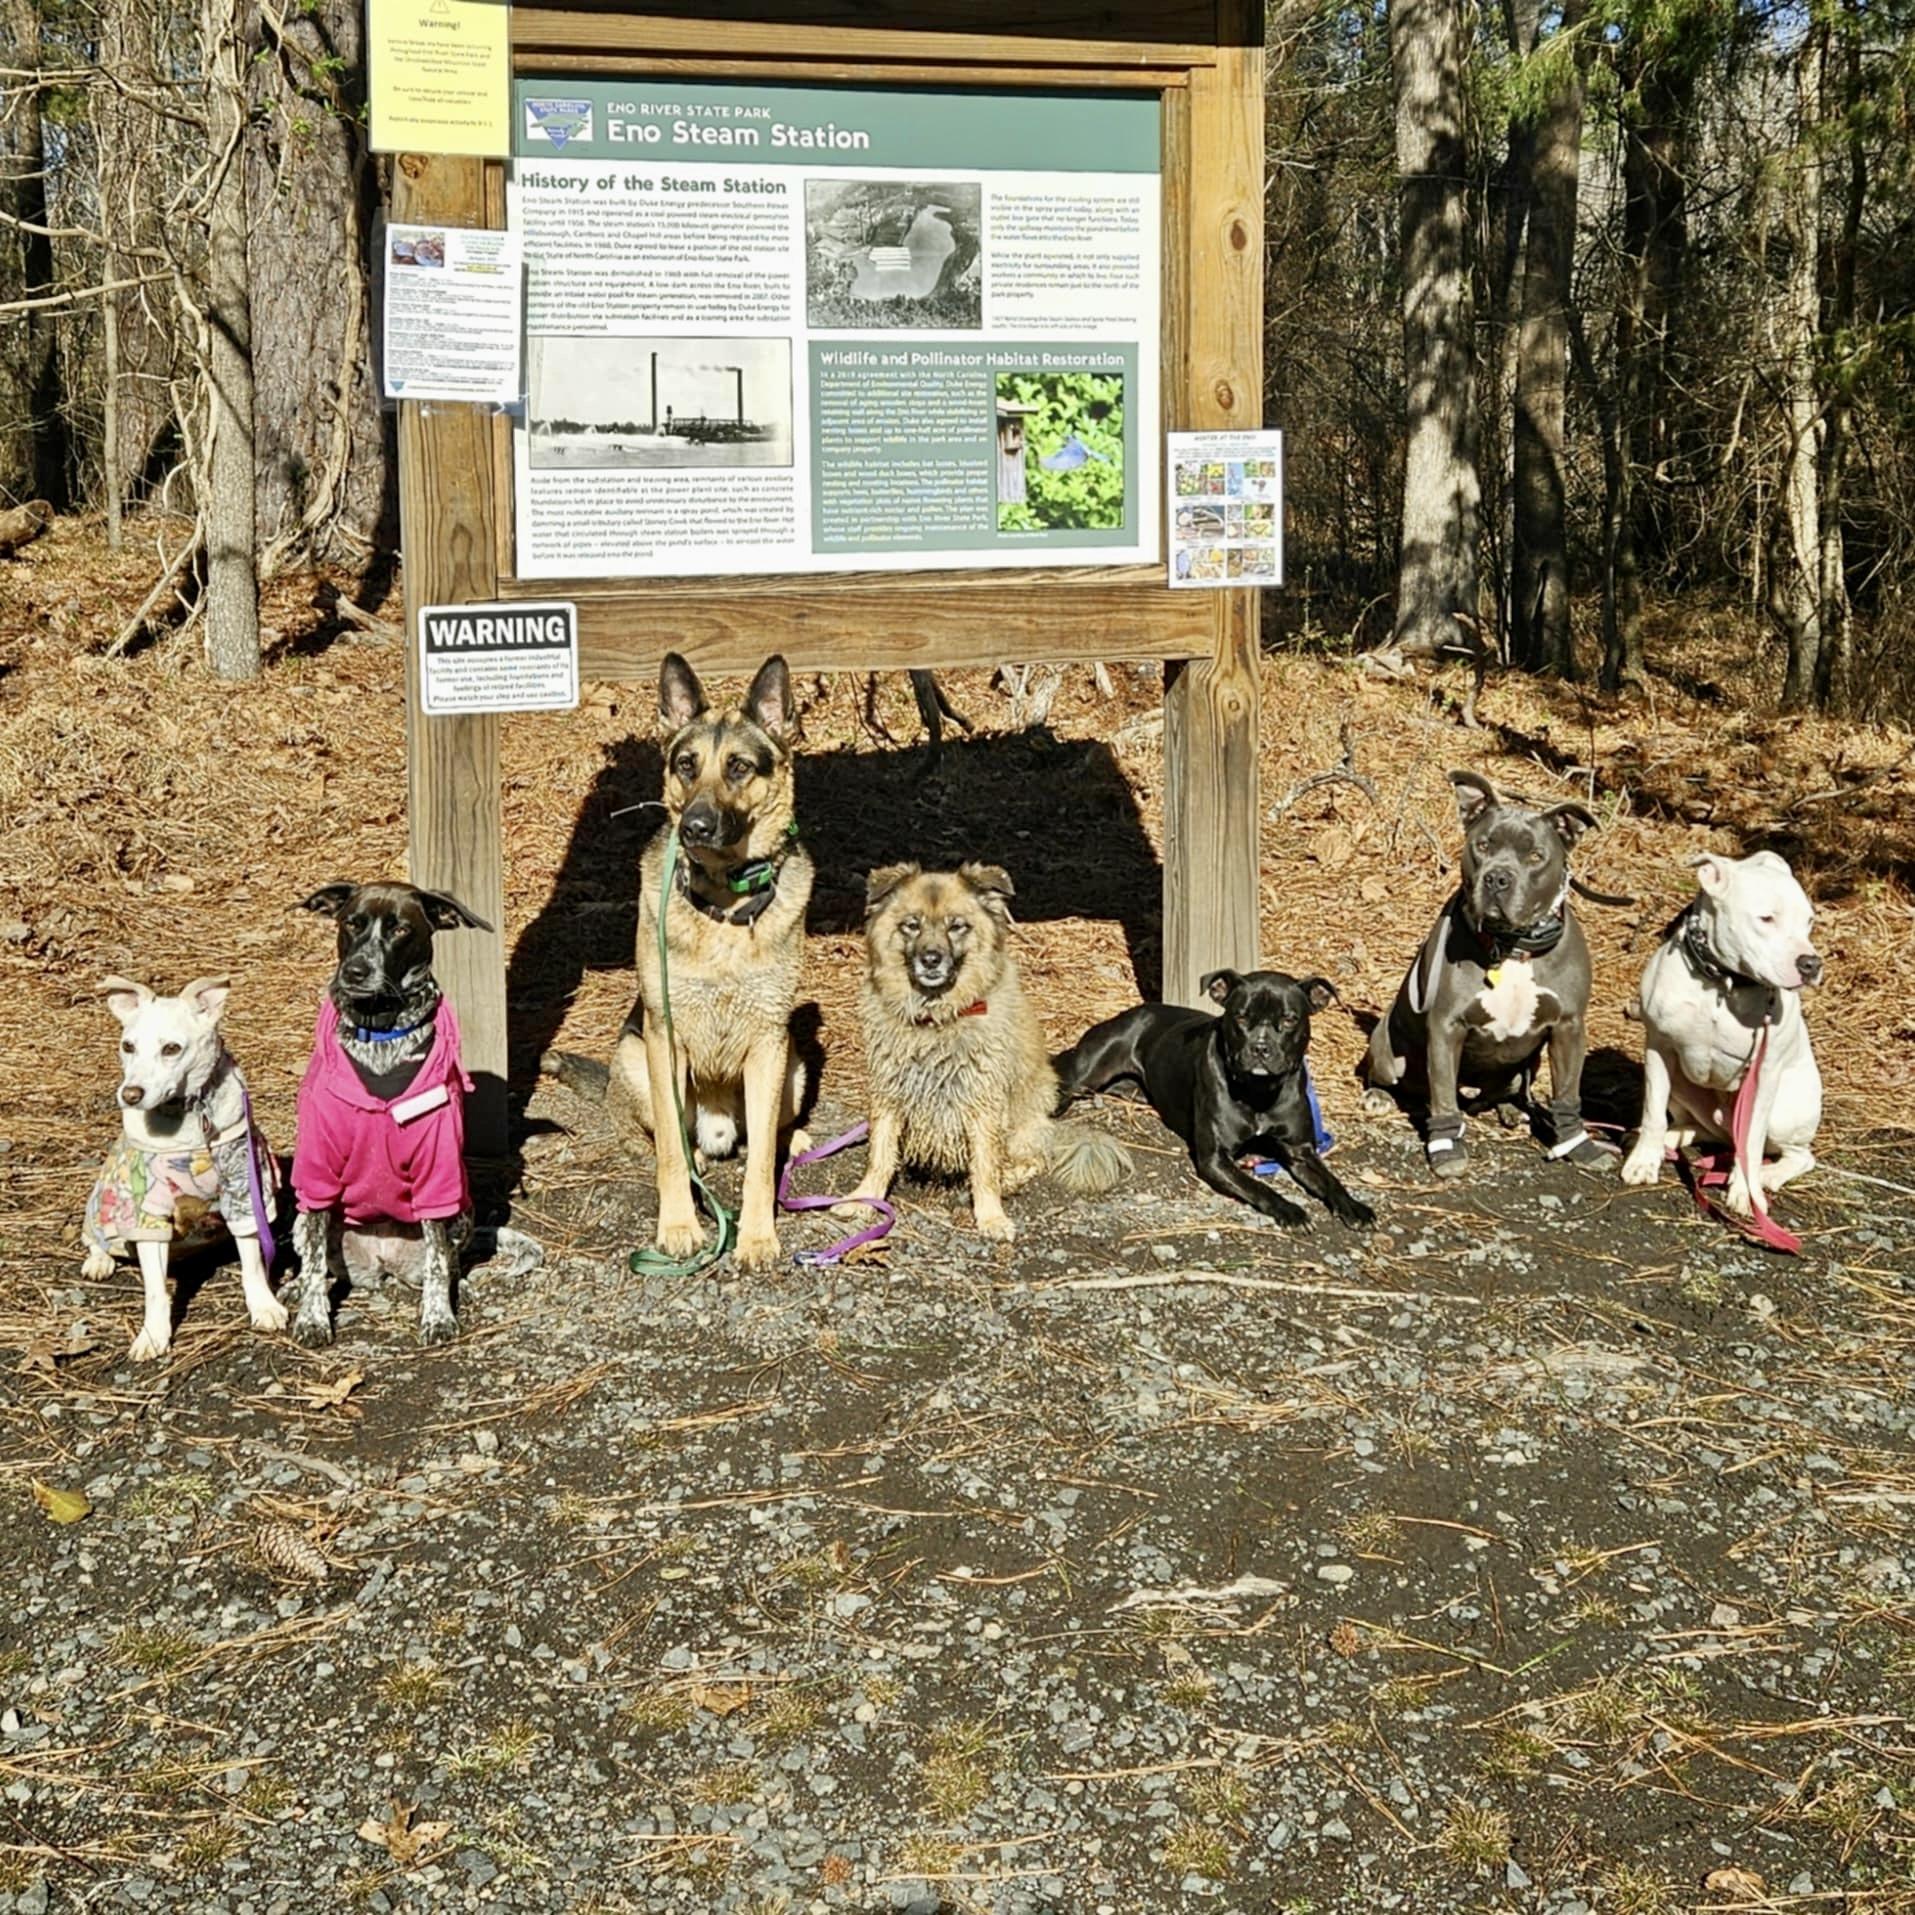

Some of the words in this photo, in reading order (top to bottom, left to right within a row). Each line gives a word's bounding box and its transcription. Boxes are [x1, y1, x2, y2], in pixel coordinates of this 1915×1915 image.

[418, 18, 461, 31] Warning!
[607, 102, 636, 114] ENO
[640, 103, 682, 116] RIVER
[687, 104, 731, 117] STATE
[734, 106, 771, 119] PARK
[607, 119, 662, 143] Eno
[672, 120, 759, 145] Steam
[771, 123, 870, 149] Station
[521, 172, 589, 193] History
[597, 174, 617, 190] of
[624, 175, 654, 191] the
[661, 176, 716, 193] Steam
[723, 178, 787, 194] Station
[820, 352, 878, 366] Wildlife
[881, 352, 908, 366] and
[911, 352, 983, 366] Pollinator
[986, 352, 1039, 366] Habitat
[1042, 353, 1125, 367] Restoration
[429, 616, 566, 646] WARNING
